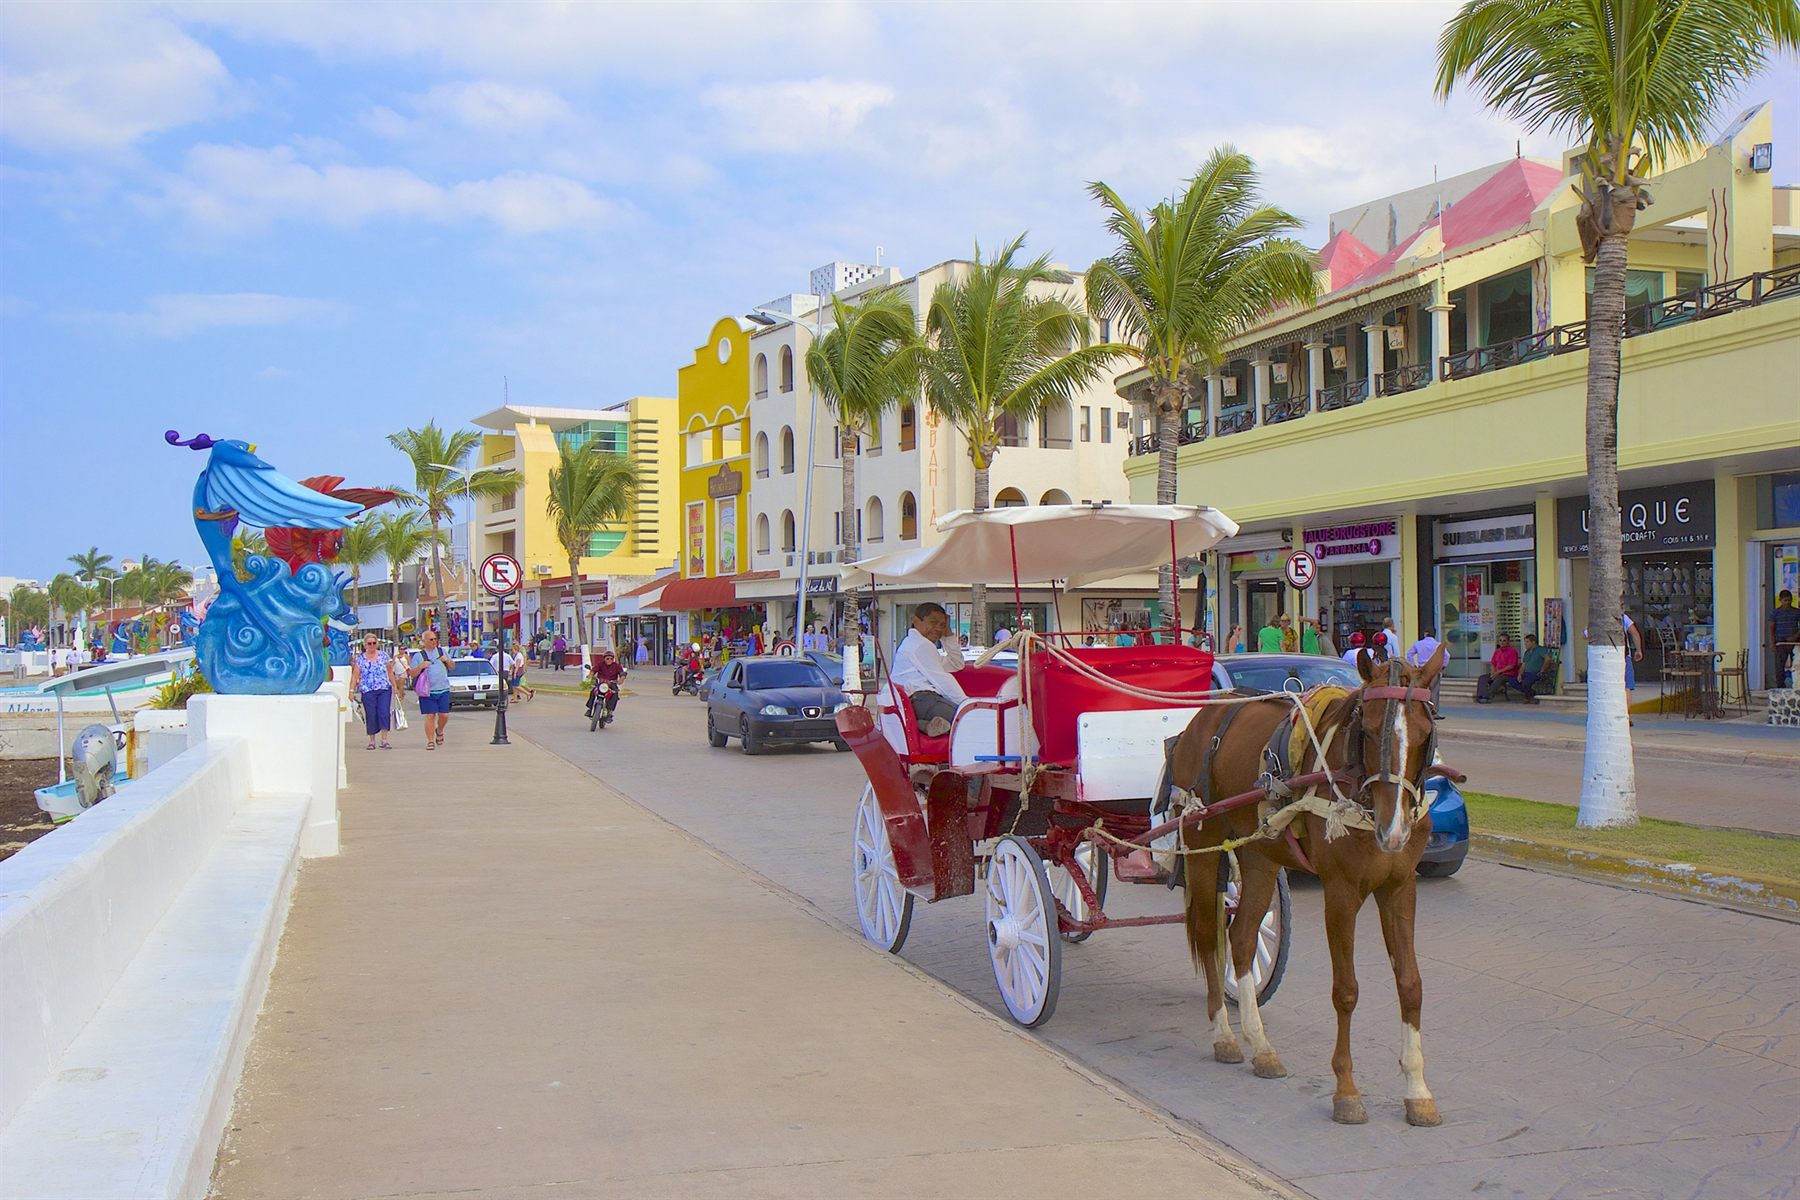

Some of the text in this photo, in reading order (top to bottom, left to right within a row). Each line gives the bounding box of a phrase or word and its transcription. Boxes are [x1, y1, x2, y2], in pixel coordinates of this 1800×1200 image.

[1582, 498, 1690, 532] UiQUE
[1303, 522, 1393, 544] VALUE DRUGSTORE
[1443, 527, 1505, 546] SUNGLASS
[1620, 530, 1656, 542] NDCRAFTS
[1325, 543, 1367, 556] FARMACIA
[492, 561, 509, 582] E
[1295, 557, 1307, 577] E
